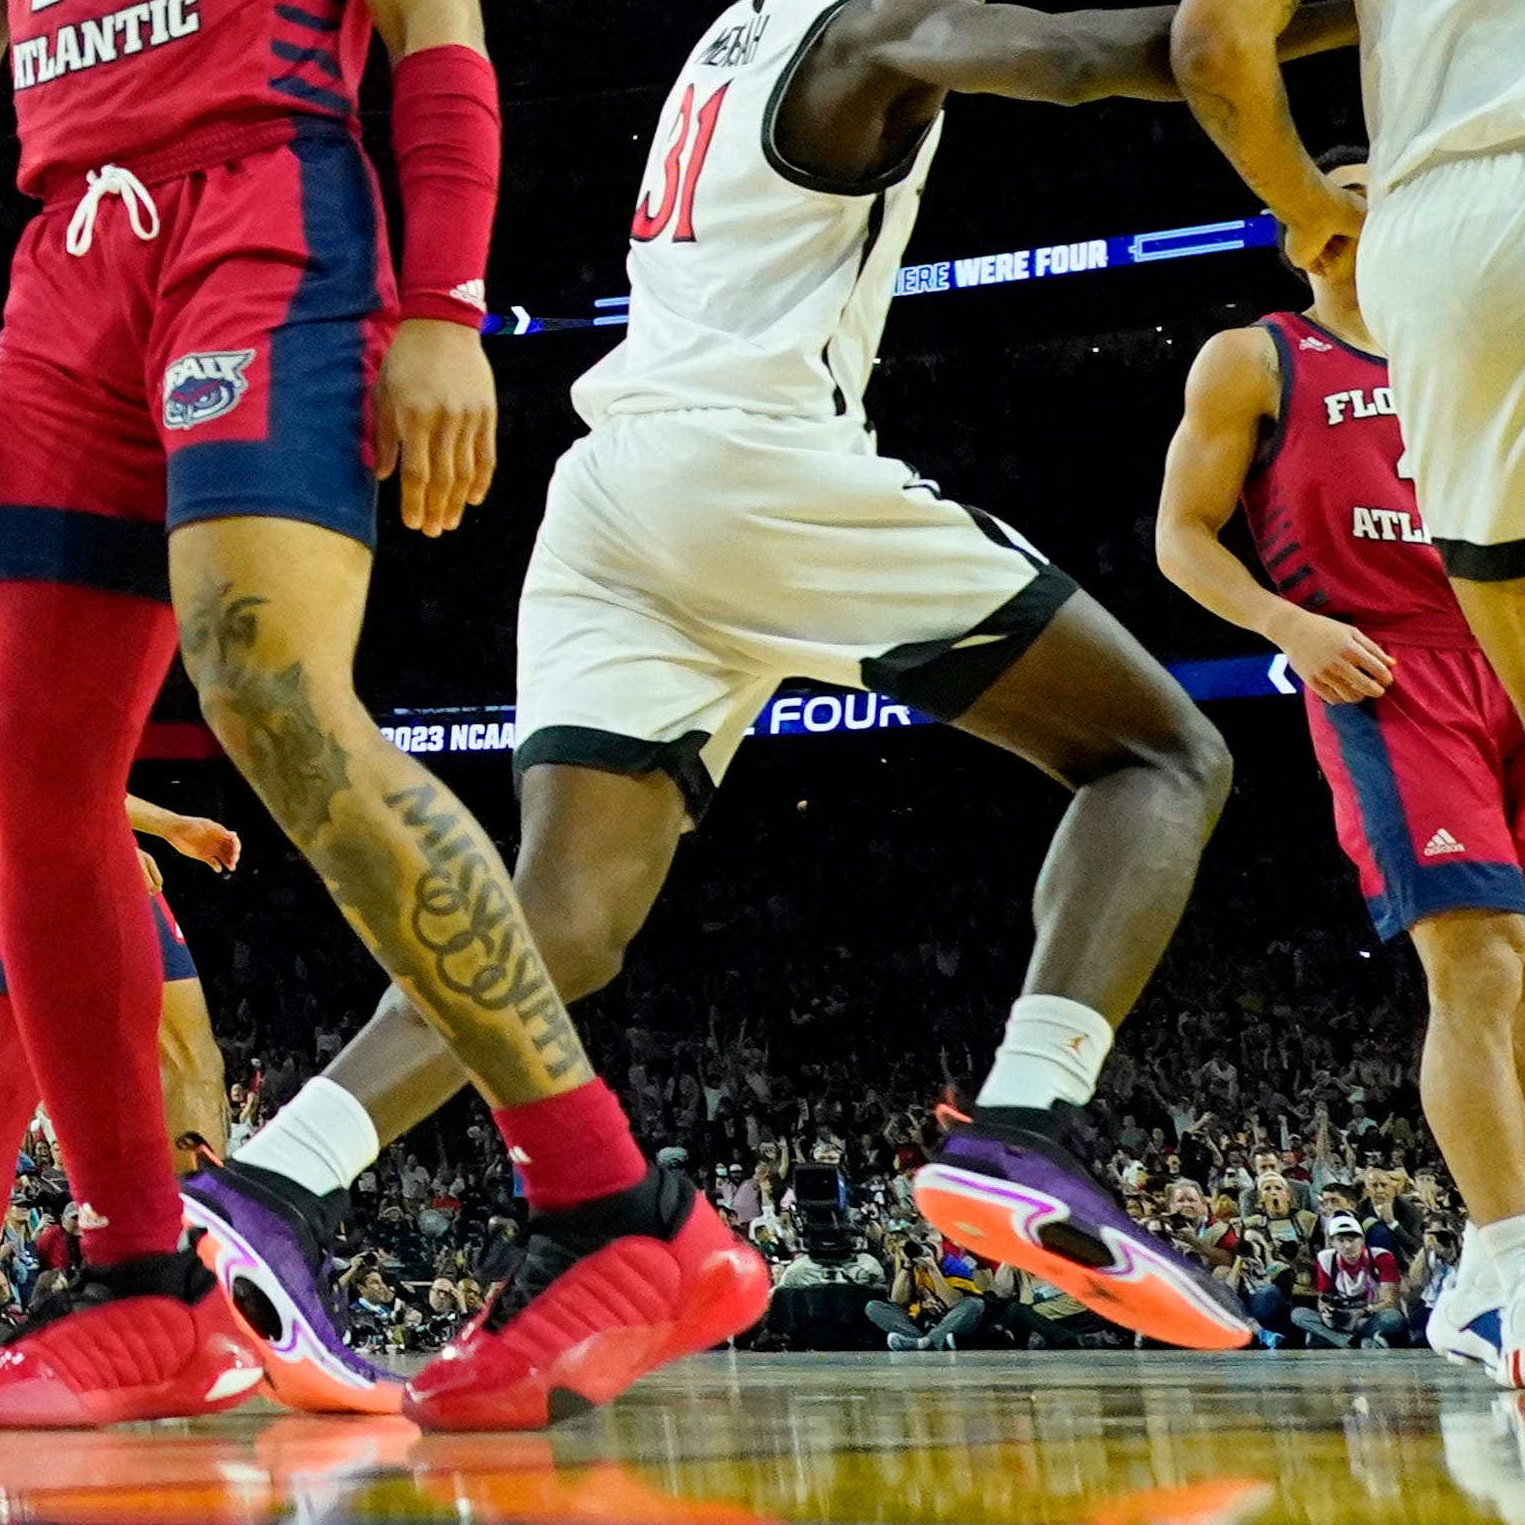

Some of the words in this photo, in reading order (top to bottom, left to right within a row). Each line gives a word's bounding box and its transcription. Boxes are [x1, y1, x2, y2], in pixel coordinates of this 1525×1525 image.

[630, 77, 735, 243] 31
[892, 261, 951, 297] ERE
[954, 249, 1031, 288] WERE
[1034, 239, 1109, 277] FOUR
[449, 721, 516, 752] NCAA
